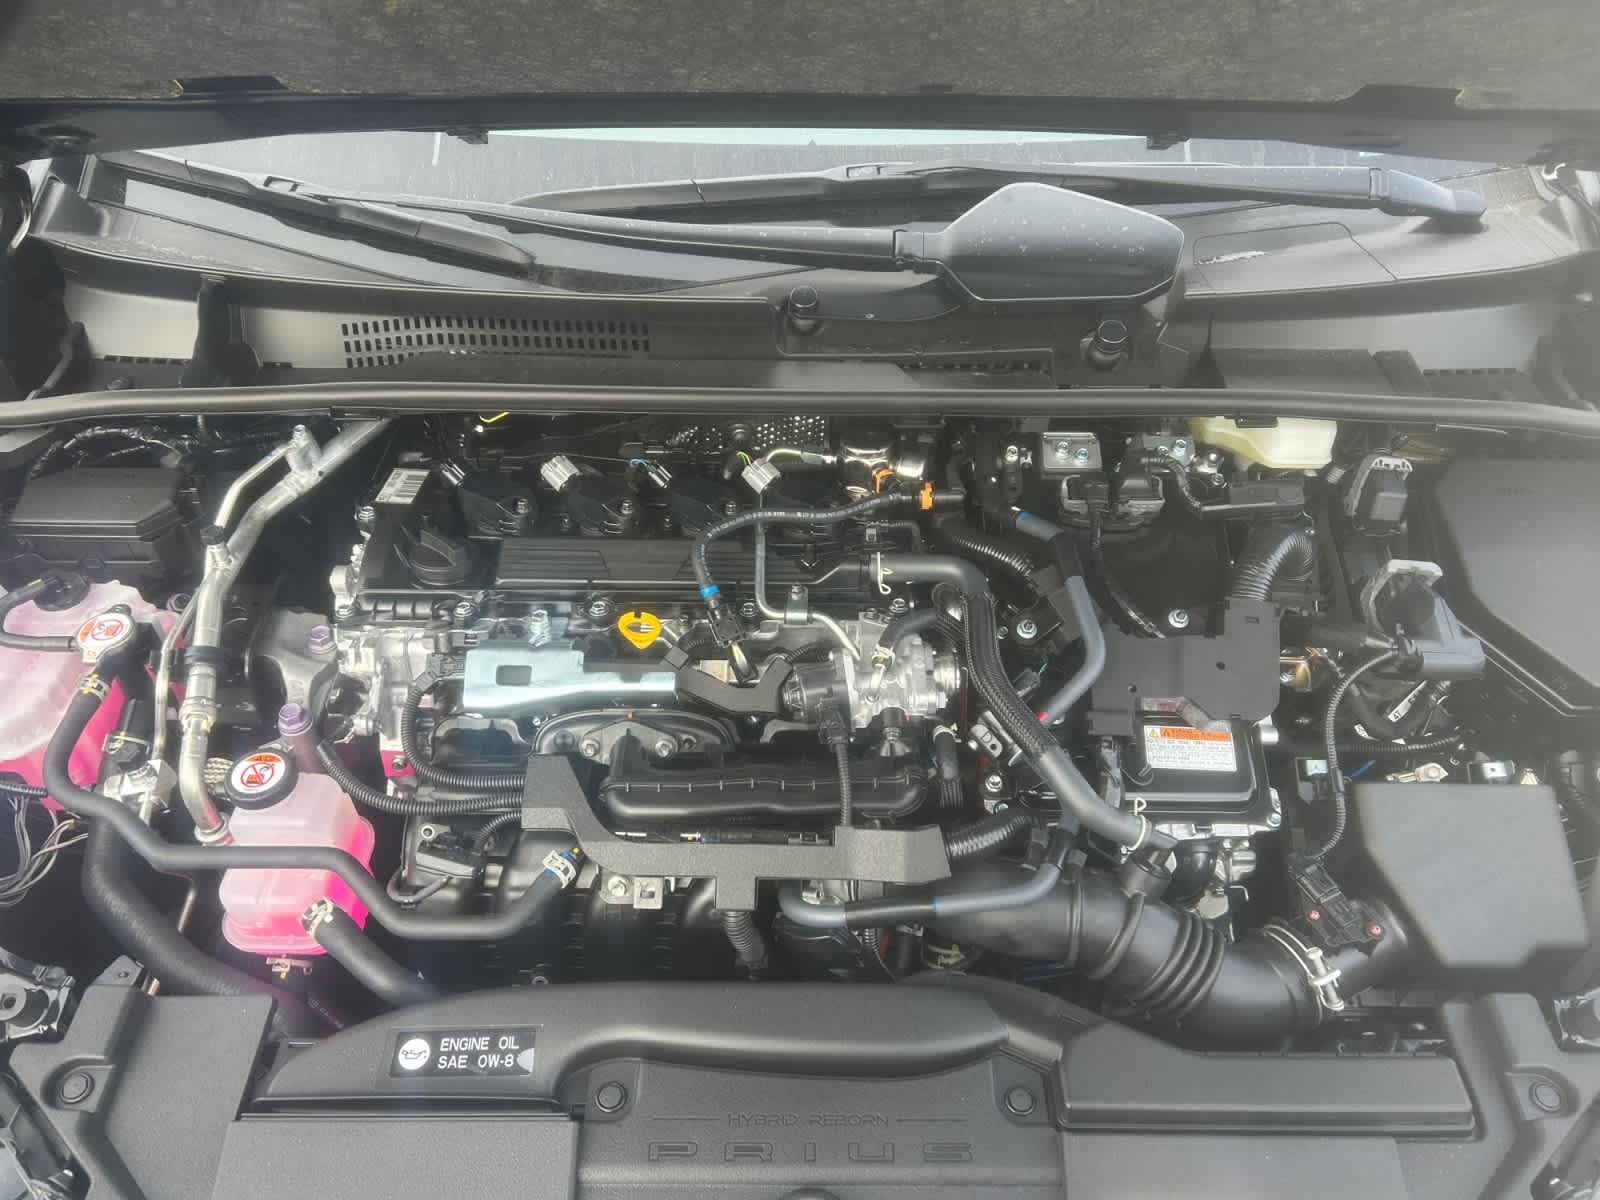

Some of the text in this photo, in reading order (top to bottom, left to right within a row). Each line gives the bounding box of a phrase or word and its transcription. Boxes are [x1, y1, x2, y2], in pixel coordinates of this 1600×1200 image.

[440, 1036, 519, 1051] ENGINE OIL
[437, 1054, 514, 1069] SAE 0W-8
[728, 1114, 888, 1128] HYBRID REBORN
[648, 1141, 973, 1163] PRIUS
